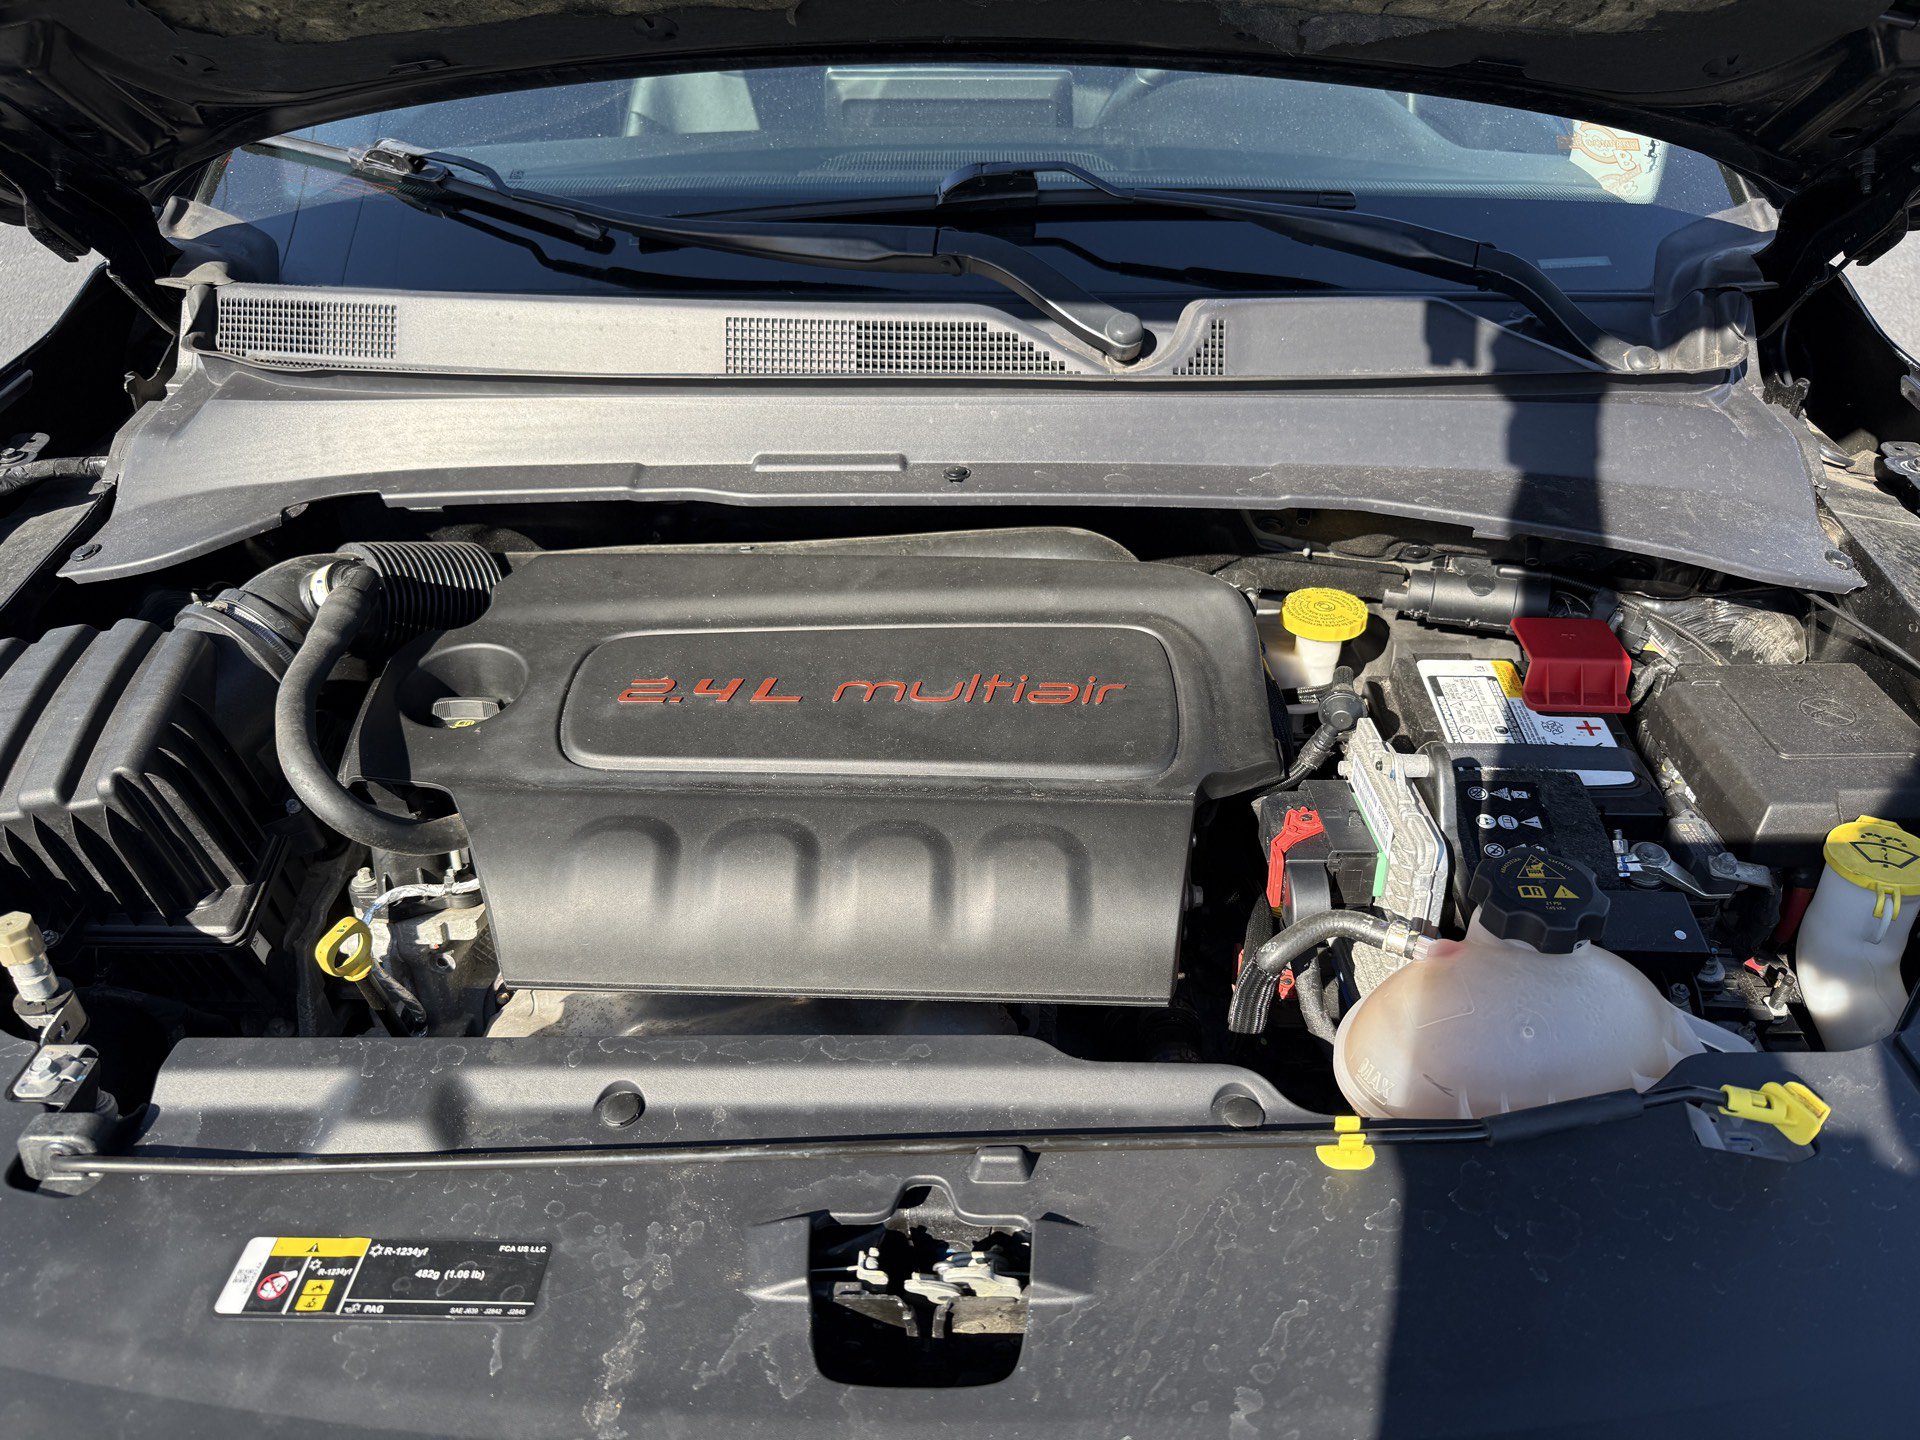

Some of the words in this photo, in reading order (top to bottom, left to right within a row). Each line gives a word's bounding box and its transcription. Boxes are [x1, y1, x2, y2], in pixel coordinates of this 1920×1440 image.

[617, 677, 805, 703] 2.4L
[832, 673, 1128, 705] multiair
[383, 1247, 430, 1258] R-1234yf
[499, 1245, 516, 1253] FCA
[414, 1268, 440, 1280] 482g
[363, 1304, 385, 1313] PAG
